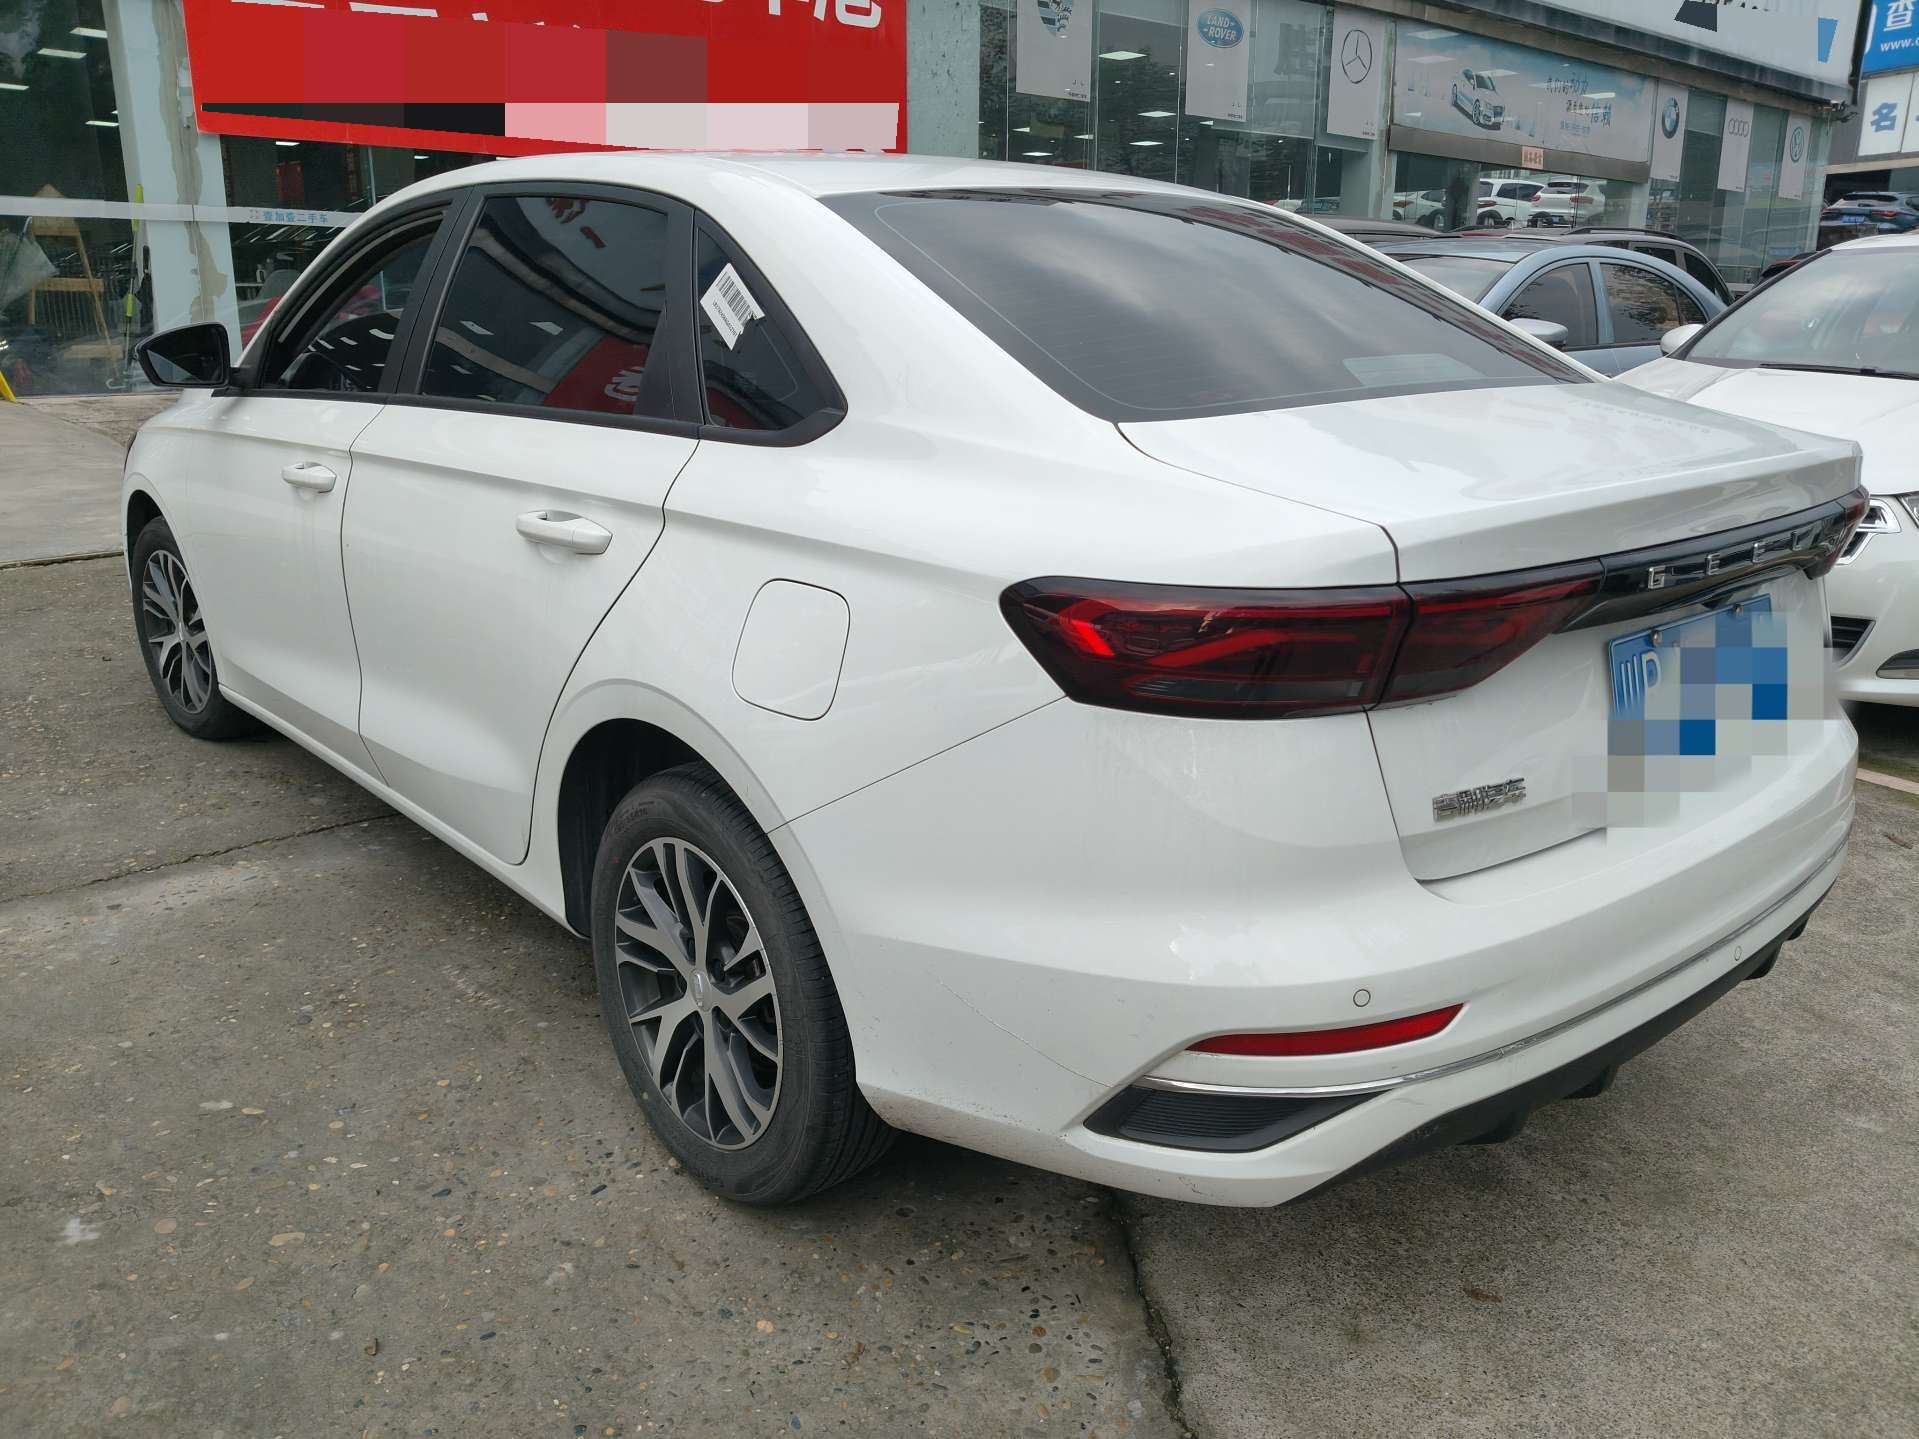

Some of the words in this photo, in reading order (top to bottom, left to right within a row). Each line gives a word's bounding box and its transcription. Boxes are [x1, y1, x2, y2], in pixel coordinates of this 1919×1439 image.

[1207, 15, 1230, 27] LAND
[1209, 26, 1237, 40] ROVER
[1871, 102, 1898, 132] 名
